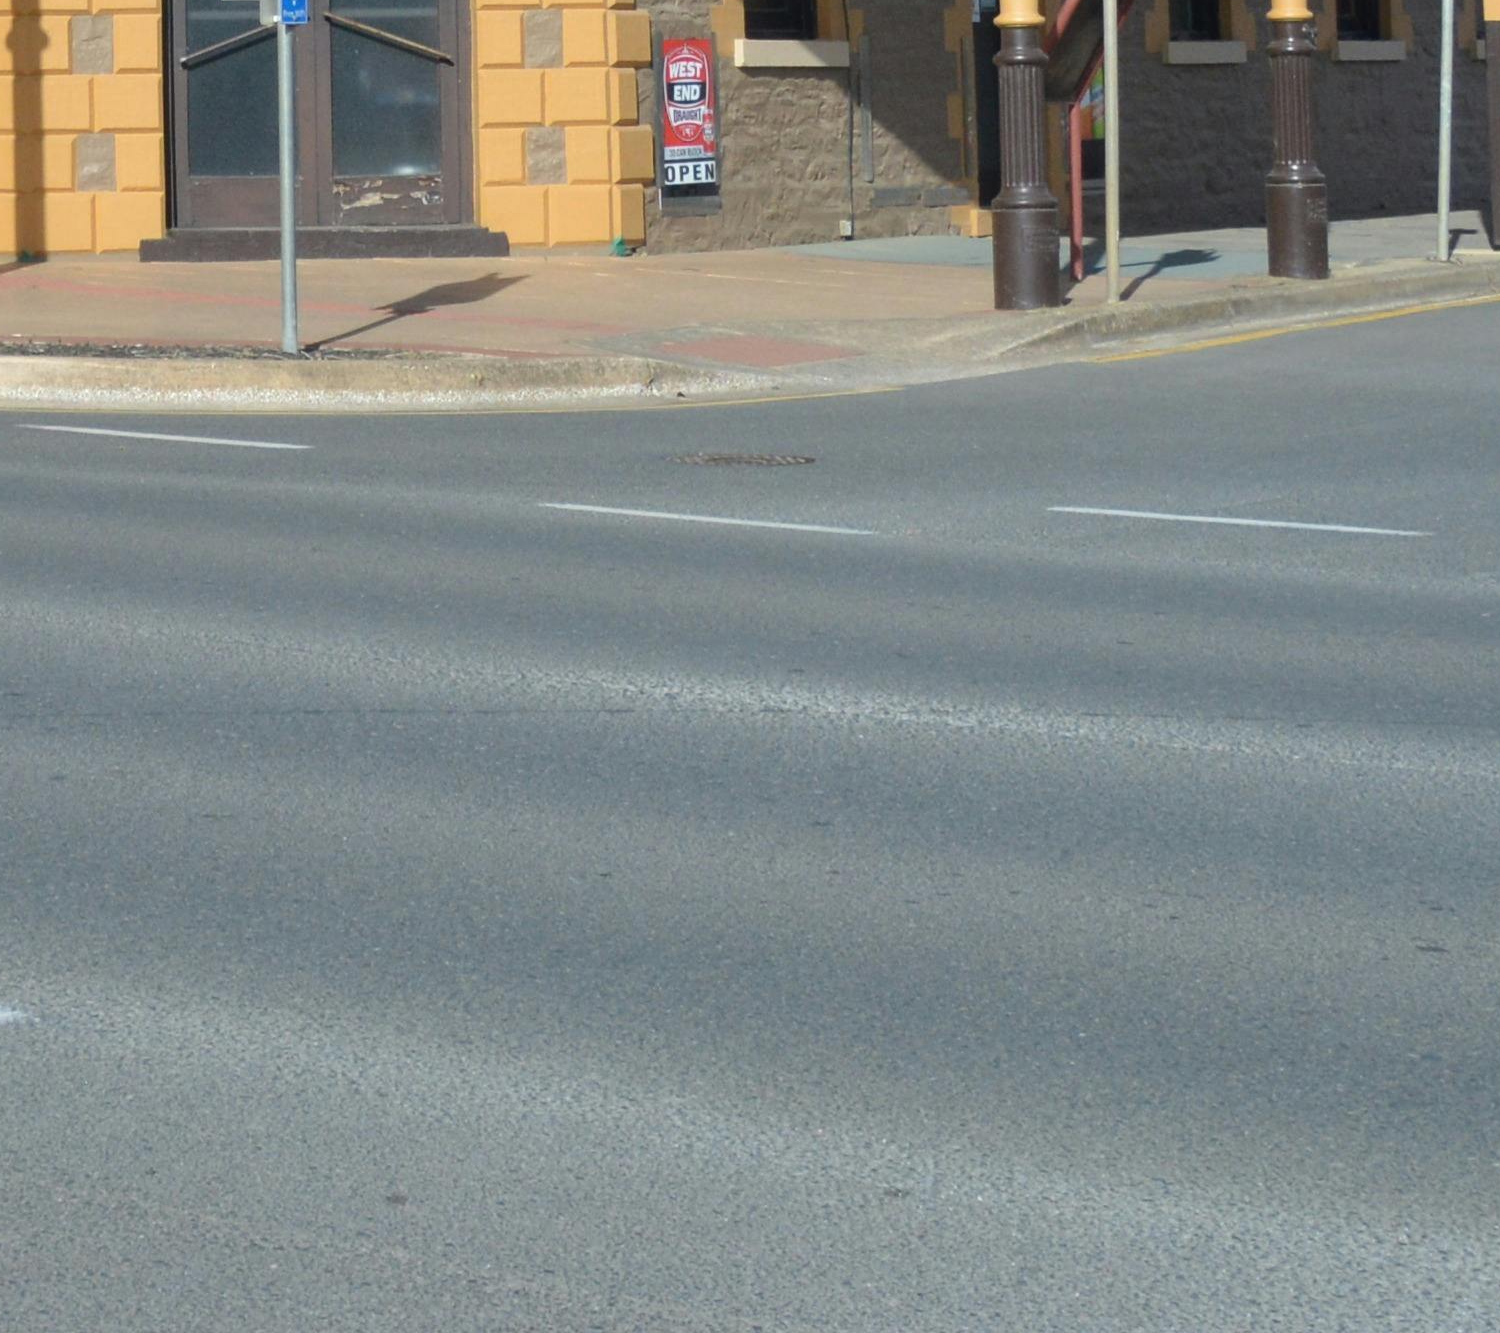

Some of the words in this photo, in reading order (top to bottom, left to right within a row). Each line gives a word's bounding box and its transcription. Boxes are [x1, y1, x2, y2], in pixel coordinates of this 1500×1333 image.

[669, 61, 702, 79] WEST
[673, 84, 700, 102] END
[673, 110, 701, 124] DRAUGHT
[665, 163, 715, 183] OPEN
